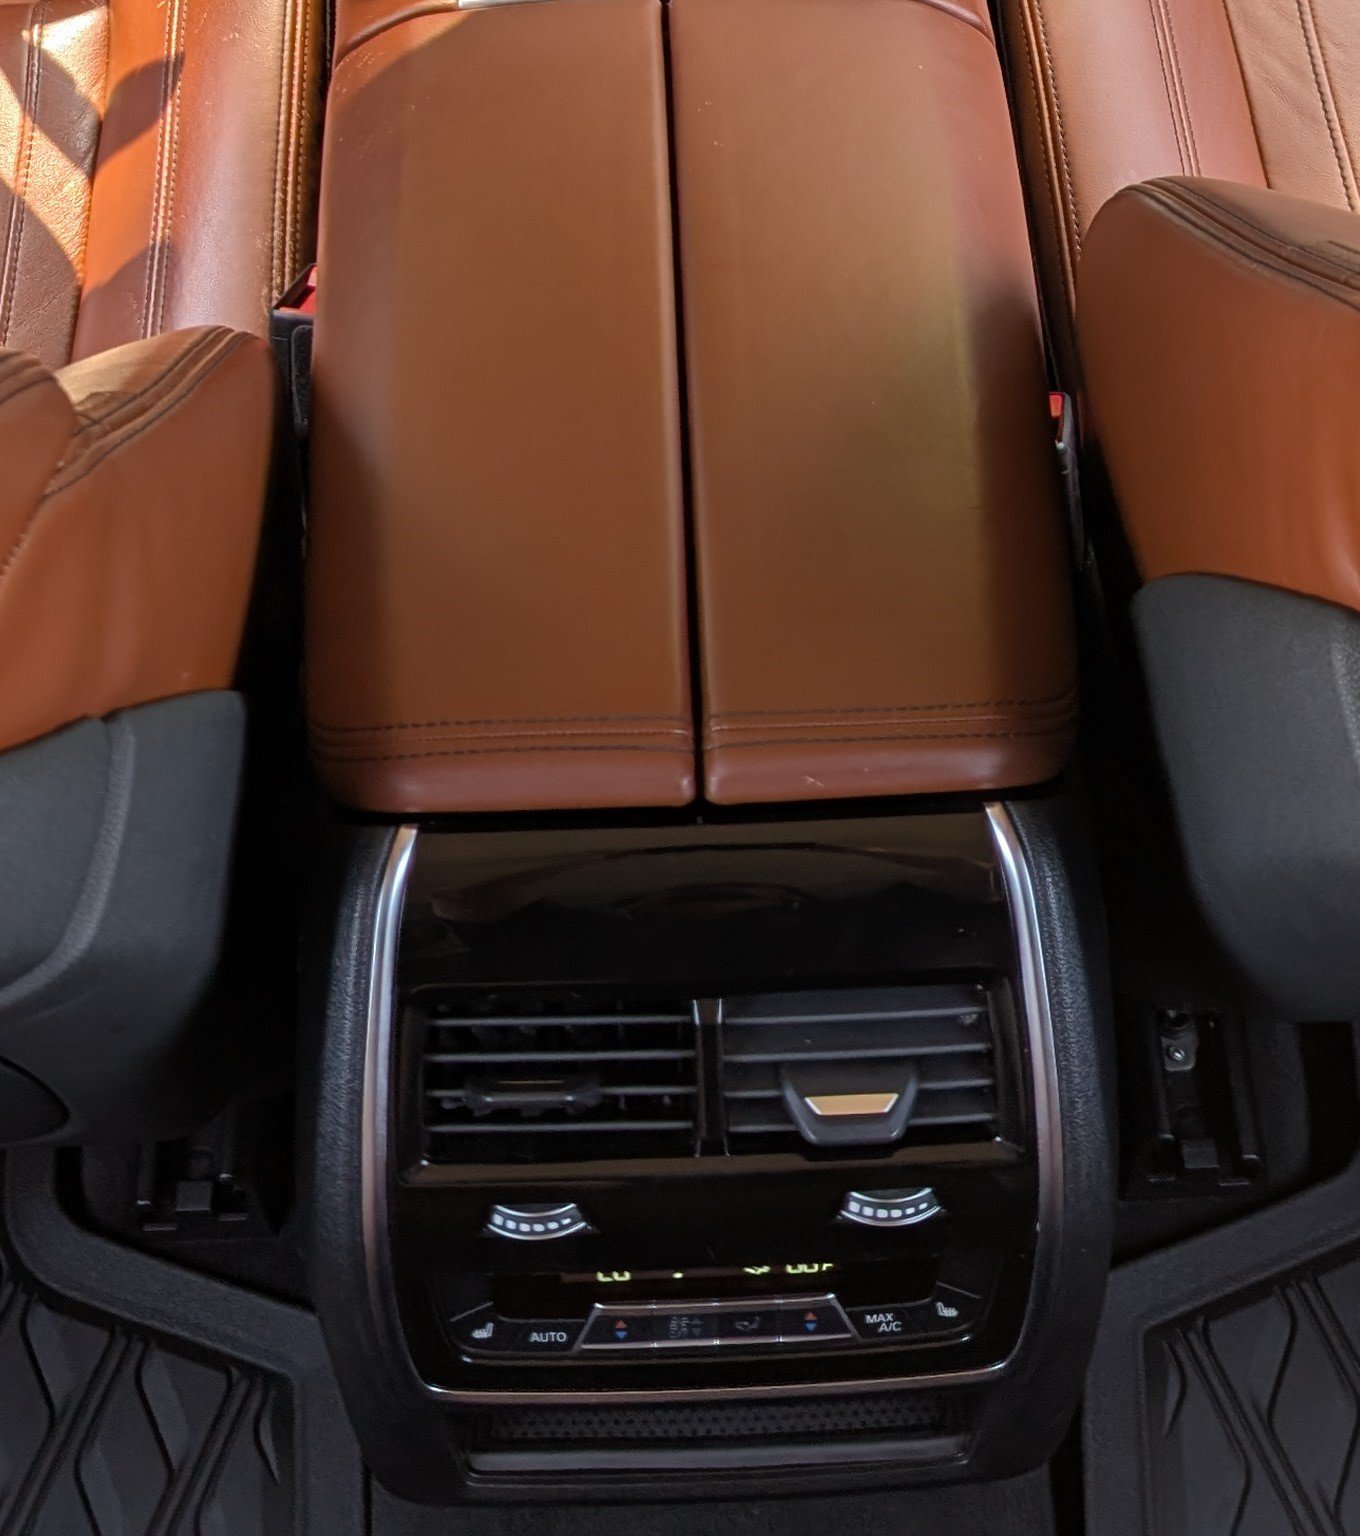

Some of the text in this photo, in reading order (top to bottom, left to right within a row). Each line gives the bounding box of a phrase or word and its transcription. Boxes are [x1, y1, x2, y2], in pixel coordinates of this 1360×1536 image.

[866, 1312, 894, 1324] MAX
[879, 1321, 902, 1333] A/C
[529, 1331, 567, 1343] AUTO
